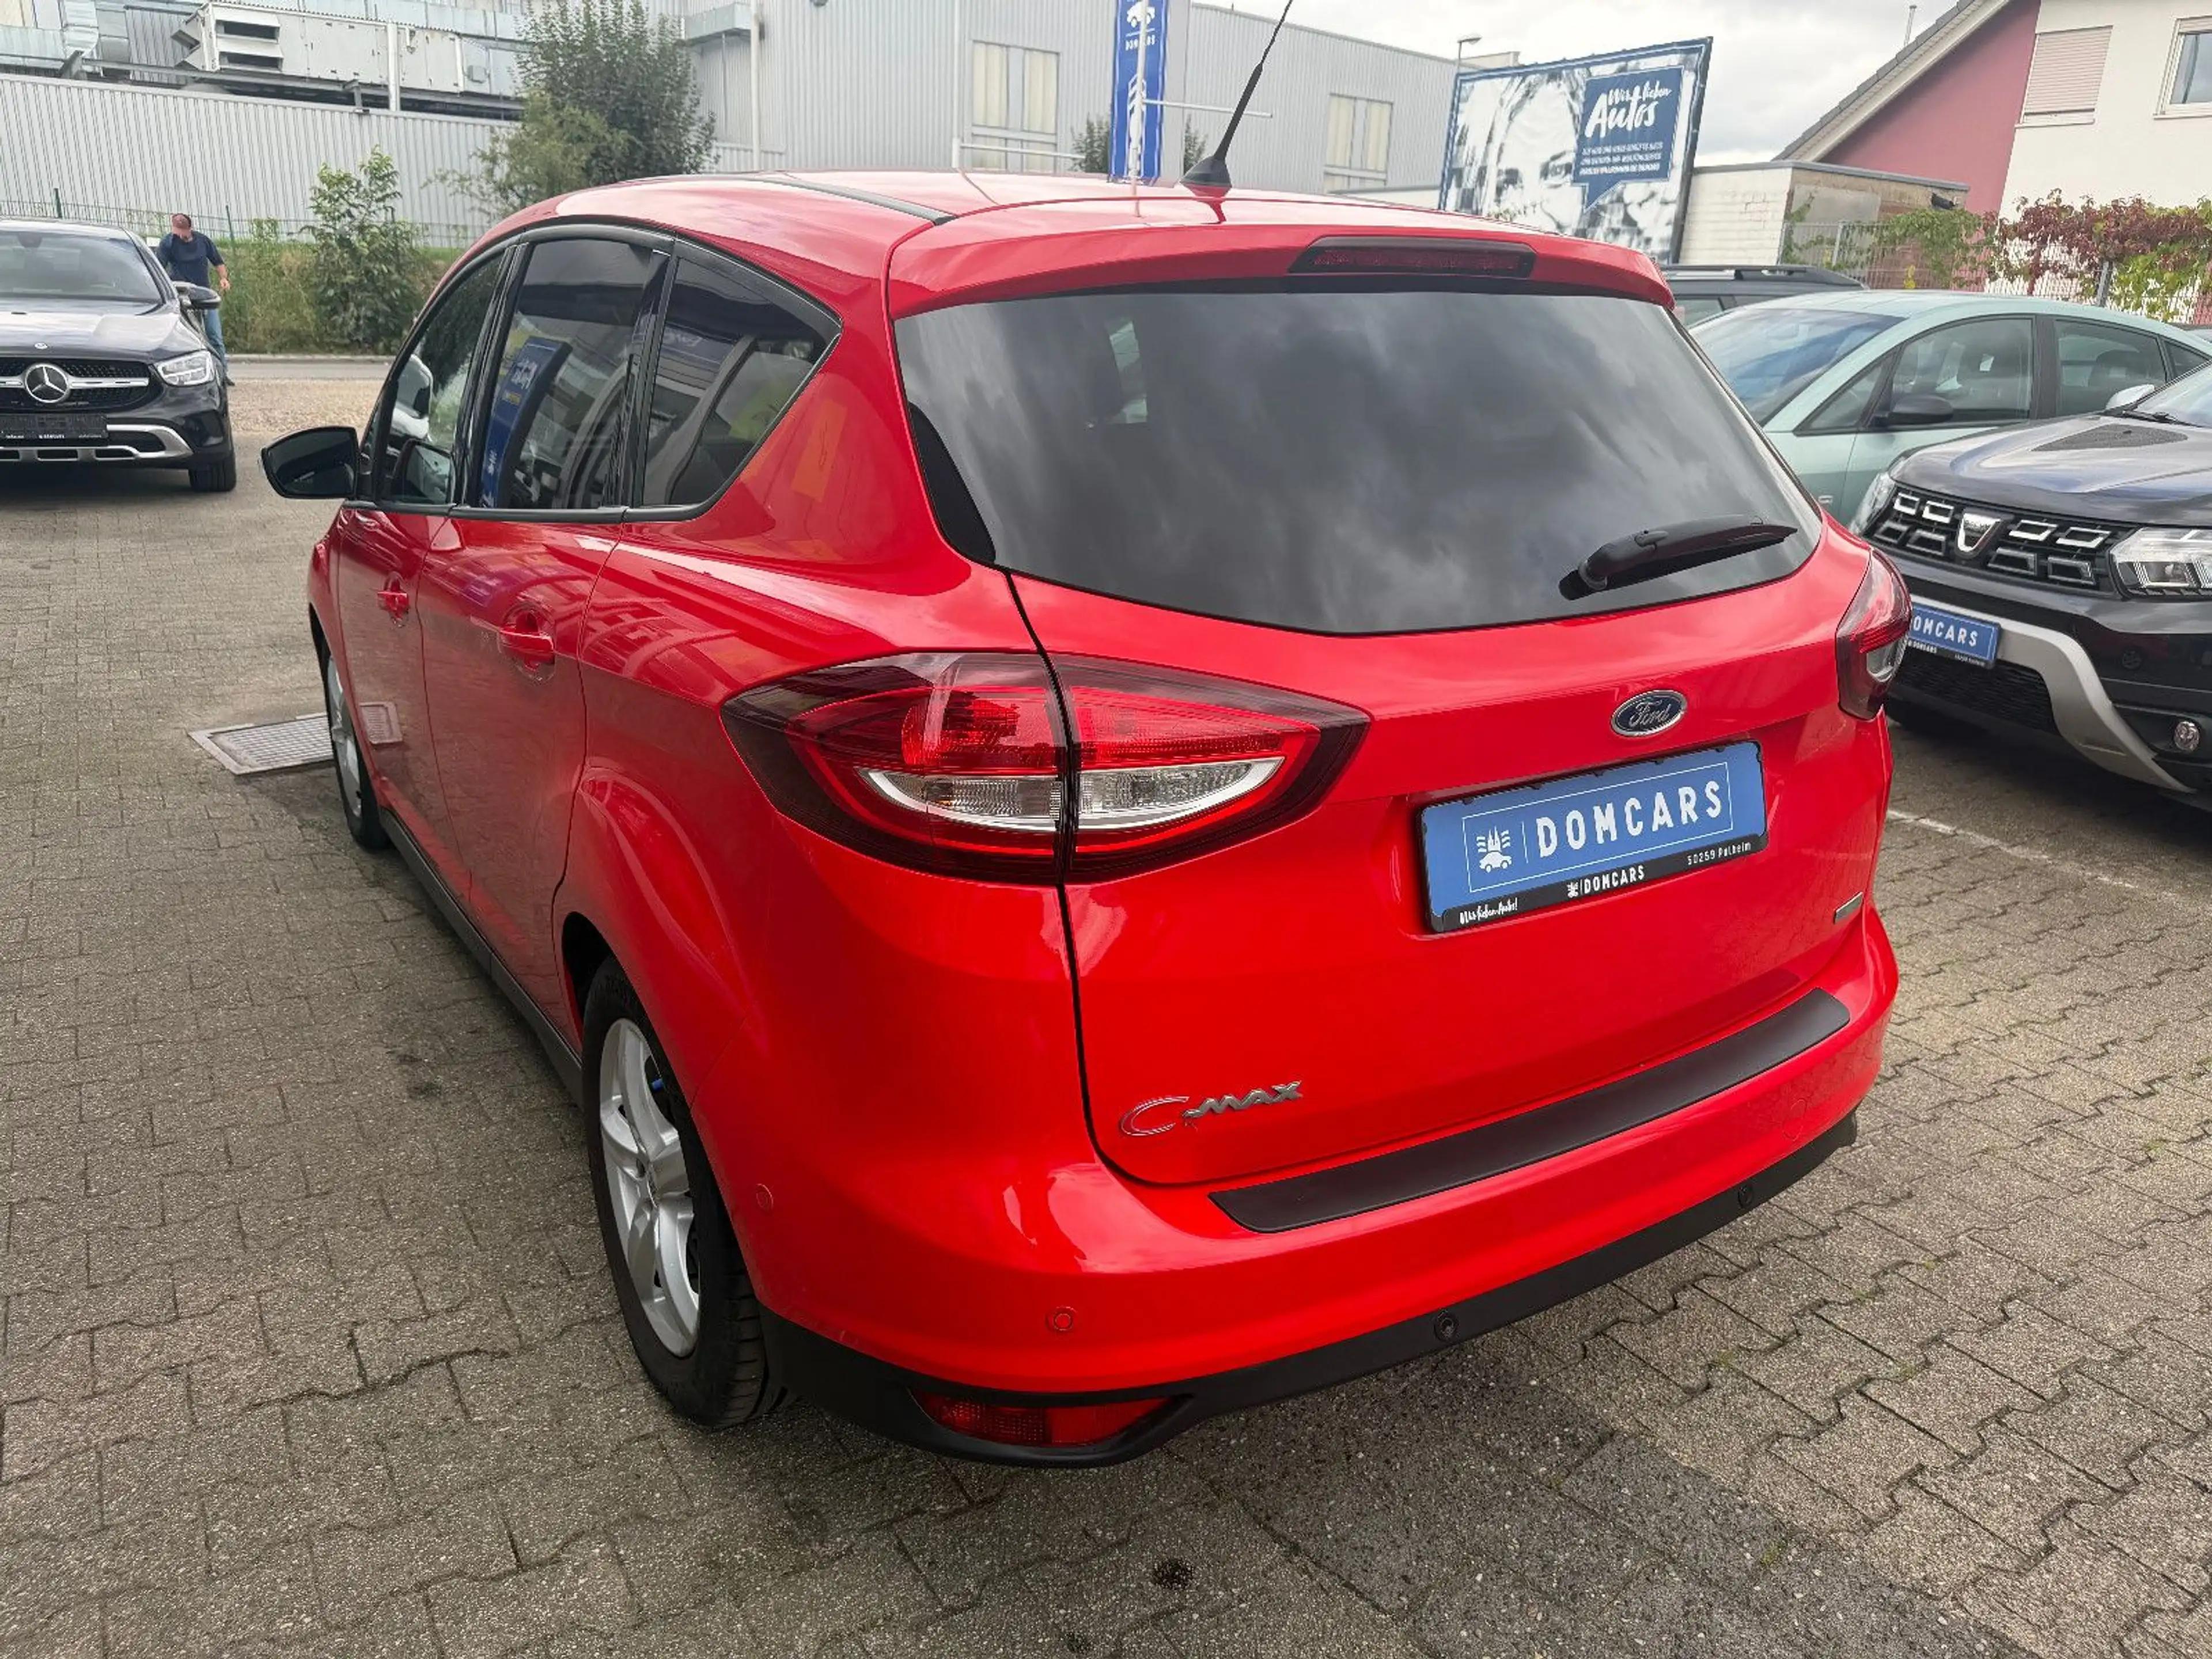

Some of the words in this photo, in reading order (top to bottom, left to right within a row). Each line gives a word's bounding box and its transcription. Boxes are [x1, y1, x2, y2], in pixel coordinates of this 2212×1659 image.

[1584, 85, 1659, 138] Autos
[1911, 615, 1978, 647] OMCARS
[1628, 699, 1672, 728] Ford
[1536, 781, 1722, 858] DOMCARS
[1687, 849, 1715, 865] 50259
[1718, 842, 1751, 858] Pulheim
[1584, 865, 1645, 894] DOMCARS
